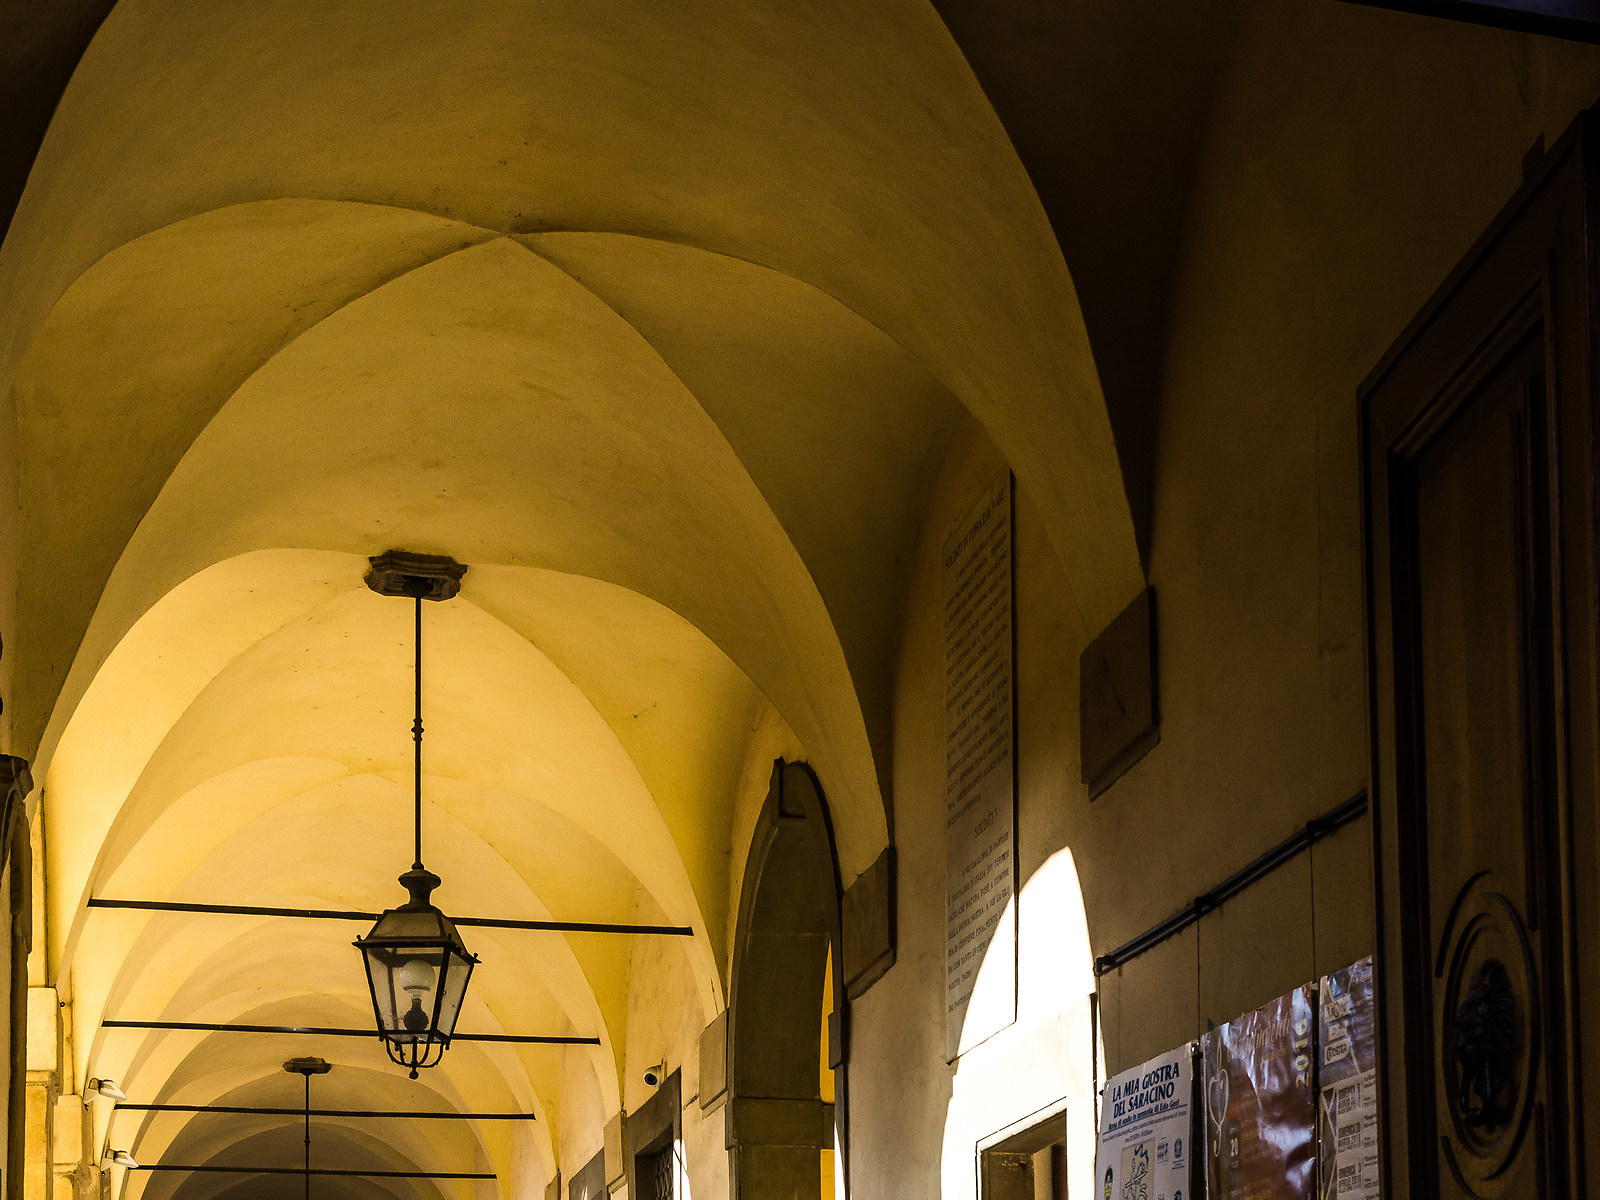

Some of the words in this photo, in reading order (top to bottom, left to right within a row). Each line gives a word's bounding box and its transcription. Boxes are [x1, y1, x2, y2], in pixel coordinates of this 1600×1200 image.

[1295, 1018, 1308, 1089] 2016
[1112, 1086, 1121, 1102] LA
[1123, 1078, 1139, 1097] MIA
[1142, 1062, 1180, 1090] GIOSTRA
[1114, 1100, 1126, 1118] DEL
[1128, 1082, 1174, 1112] SARACINO
